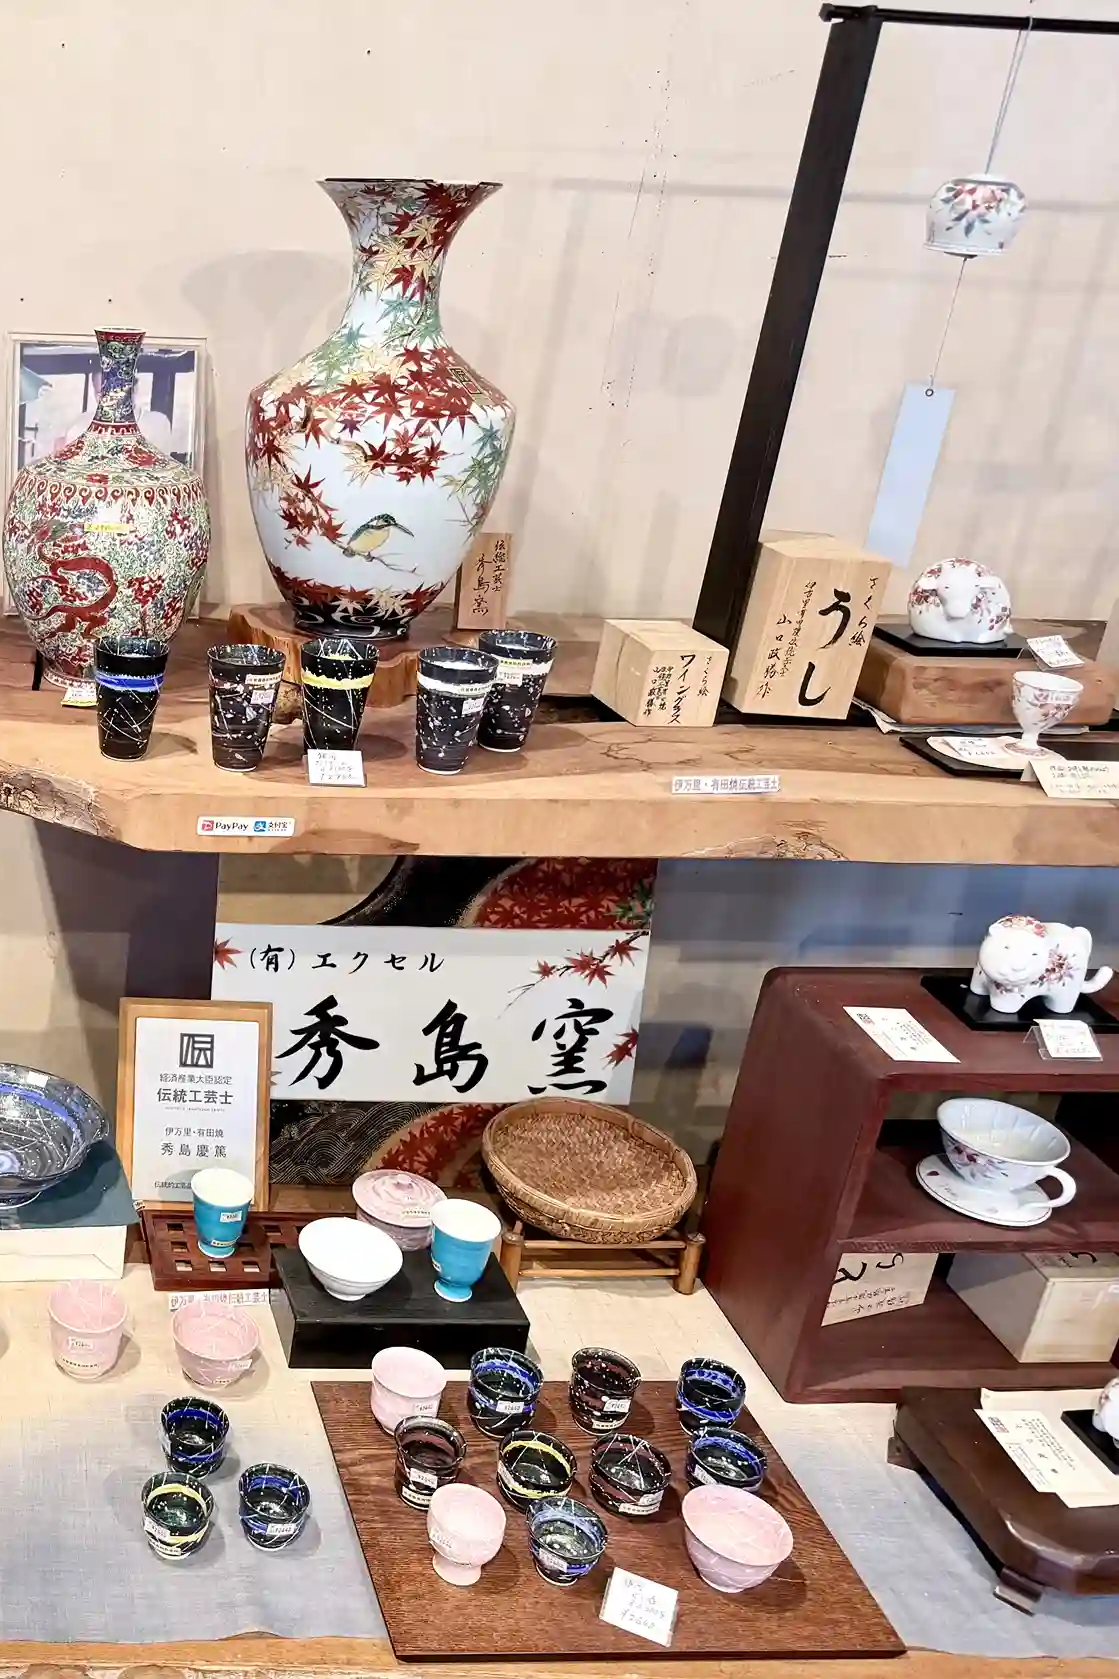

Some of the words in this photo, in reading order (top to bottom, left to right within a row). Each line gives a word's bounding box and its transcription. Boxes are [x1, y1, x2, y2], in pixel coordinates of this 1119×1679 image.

[797, 587, 852, 707] うし
[666, 653, 697, 725] ワイングラス
[215, 821, 249, 831] PayPay
[275, 993, 615, 1095] 秀島窯
[159, 1073, 233, 1086] 経済産業大臣認定
[156, 1088, 234, 1105] 伝統工芸士
[165, 1126, 224, 1138] 伊万里・有田焼
